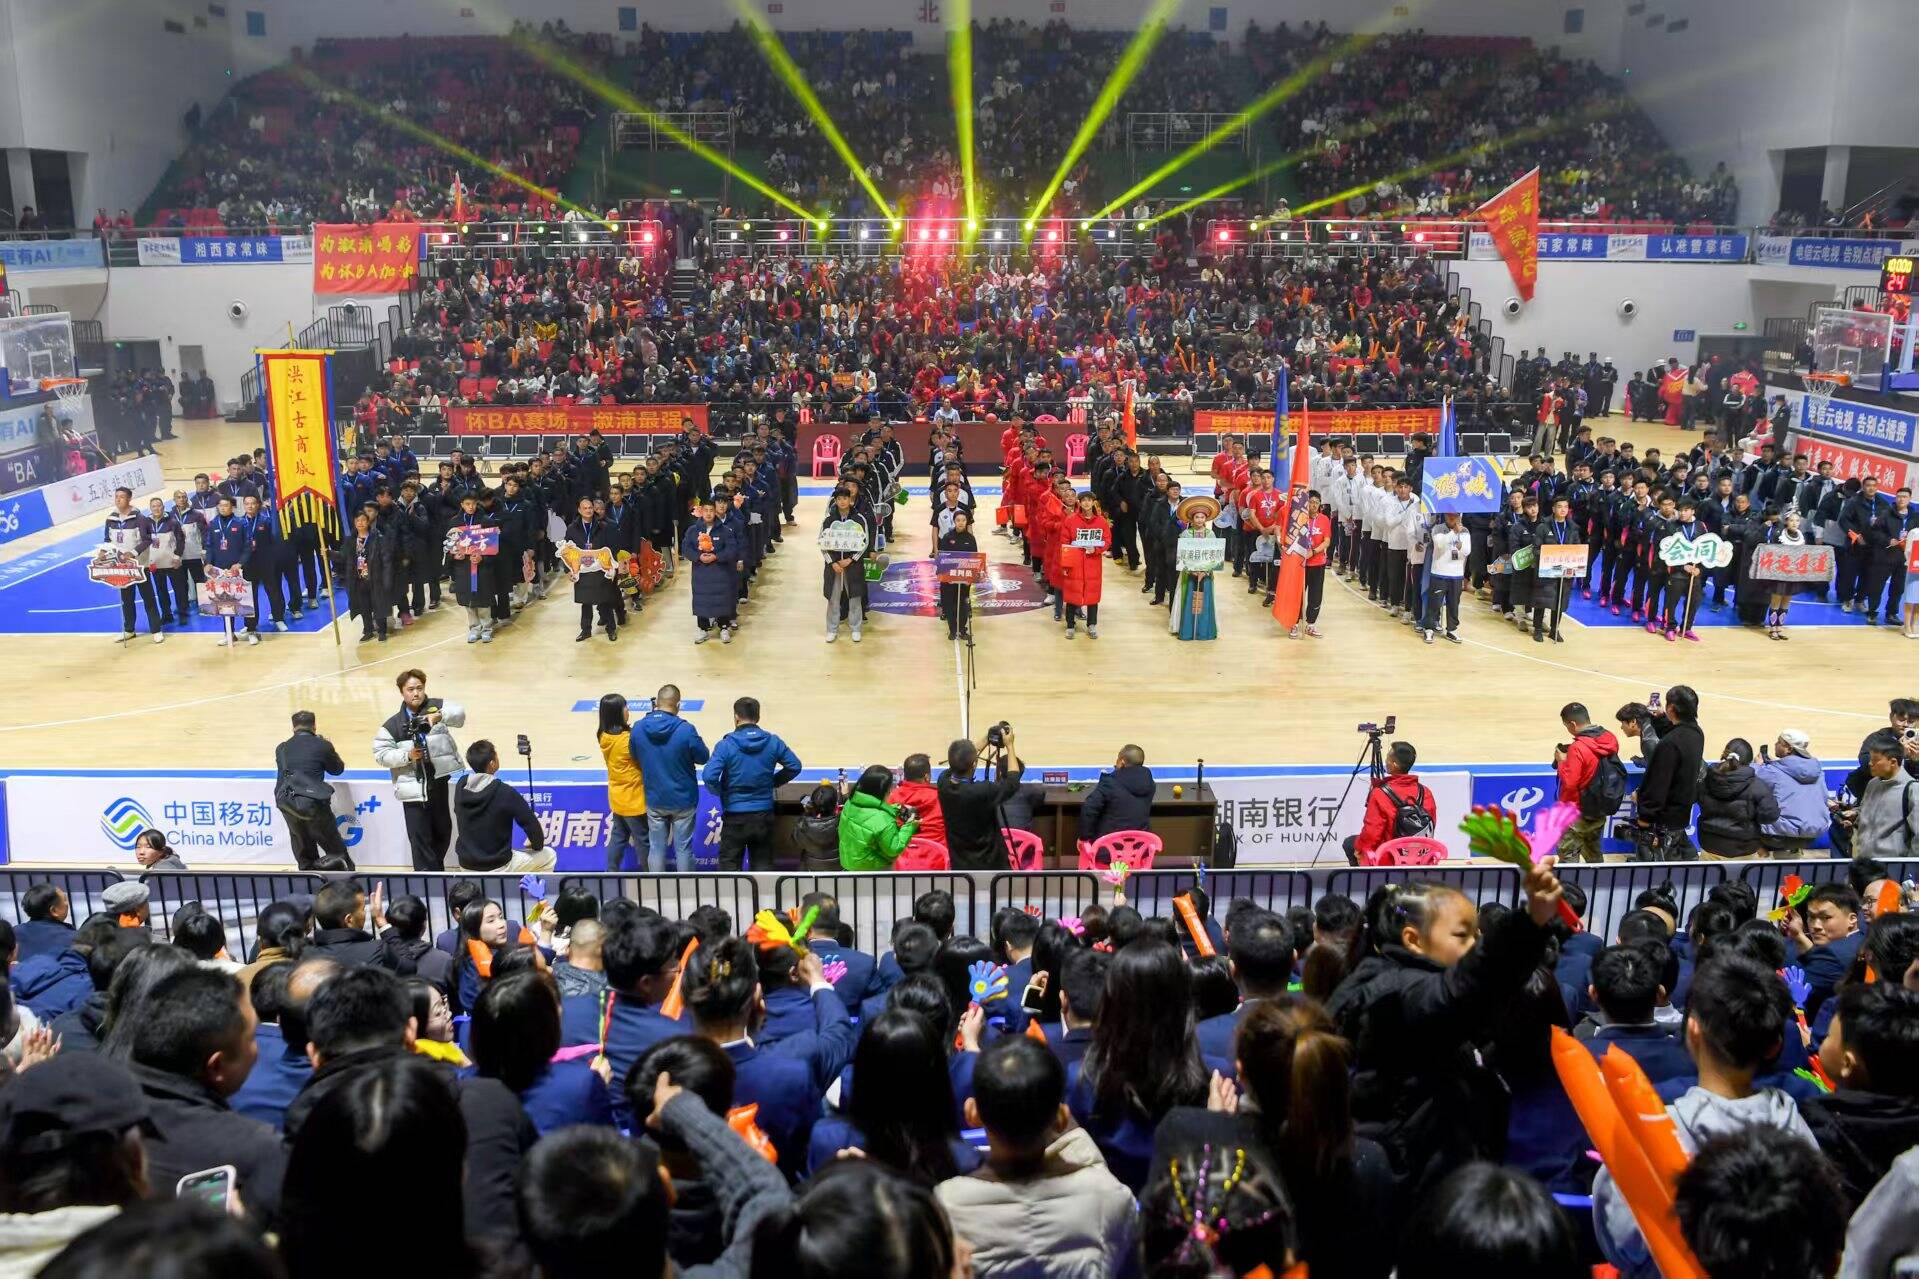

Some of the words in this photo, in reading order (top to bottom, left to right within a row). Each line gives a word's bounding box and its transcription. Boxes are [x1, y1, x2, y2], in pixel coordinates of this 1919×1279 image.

[194, 242, 269, 257] 湘西家常味
[1537, 236, 1593, 253] 西家常味
[1796, 244, 1841, 263] 电信云电视
[1887, 274, 1903, 291] 24
[1077, 528, 1103, 541] 沅陵
[1665, 537, 1718, 561] 会同
[949, 569, 973, 577] 裁判员
[164, 800, 272, 827] 中国移动
[1214, 797, 1339, 829] 湖南银行
[524, 810, 614, 848] 湖南
[1252, 833, 1274, 844] OF
[1281, 831, 1339, 843] HUNAN
[166, 829, 215, 847] China
[219, 829, 273, 847] Mobile
